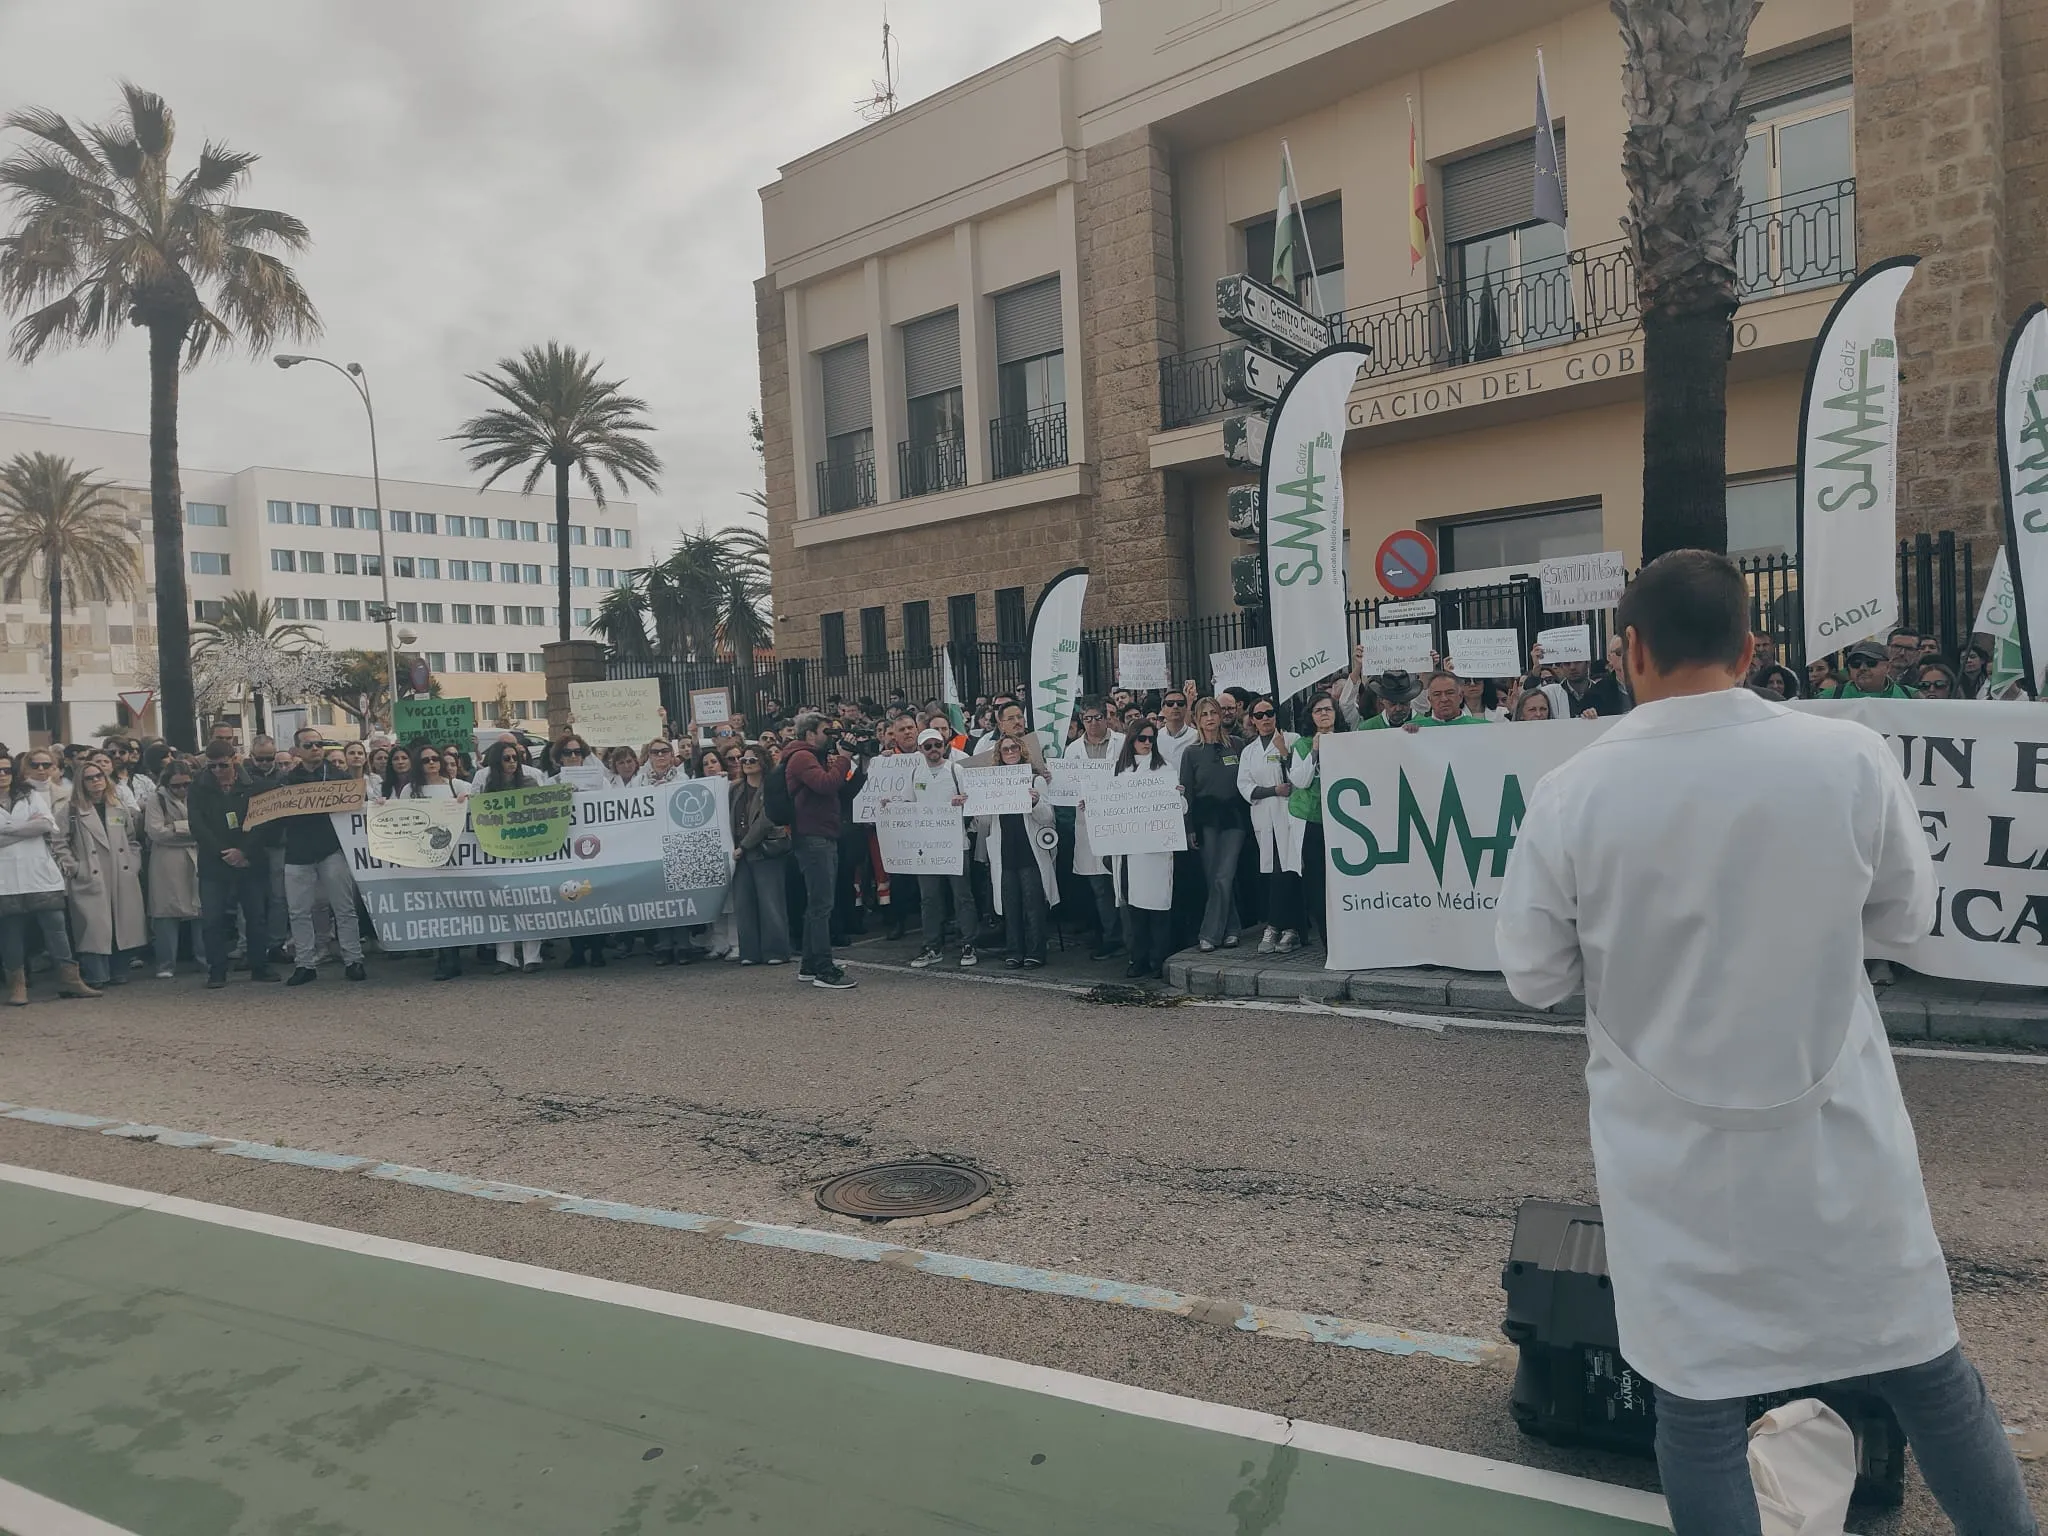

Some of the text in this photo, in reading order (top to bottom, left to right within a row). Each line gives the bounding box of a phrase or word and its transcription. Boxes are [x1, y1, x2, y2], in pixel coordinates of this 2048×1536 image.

[1270, 299, 1328, 345] Centro Ciudad
[1838, 339, 1857, 392] Cádiz
[1348, 381, 1463, 426] GACION
[1482, 367, 1542, 399] DEL
[1814, 349, 1888, 512] SMA
[1295, 443, 1307, 475] Cádiz
[1269, 442, 1327, 587] SMA
[422, 716, 460, 729] NO ES
[881, 758, 921, 769] LLAMAN
[583, 795, 655, 825] DIGNAS
[1917, 810, 1952, 862] E
[378, 892, 400, 915] AL
[404, 889, 487, 915] ESTATUTO
[382, 922, 402, 942] AL
[406, 914, 485, 941] DERECHO
[488, 914, 510, 934] DE
[513, 903, 625, 933] NEGOCIACIÓN
[628, 897, 698, 923] DIRECTA
[1342, 890, 1432, 912] Sindicato
[1929, 886, 2048, 947] ICA
[1621, 1369, 1633, 1410] VONYX
